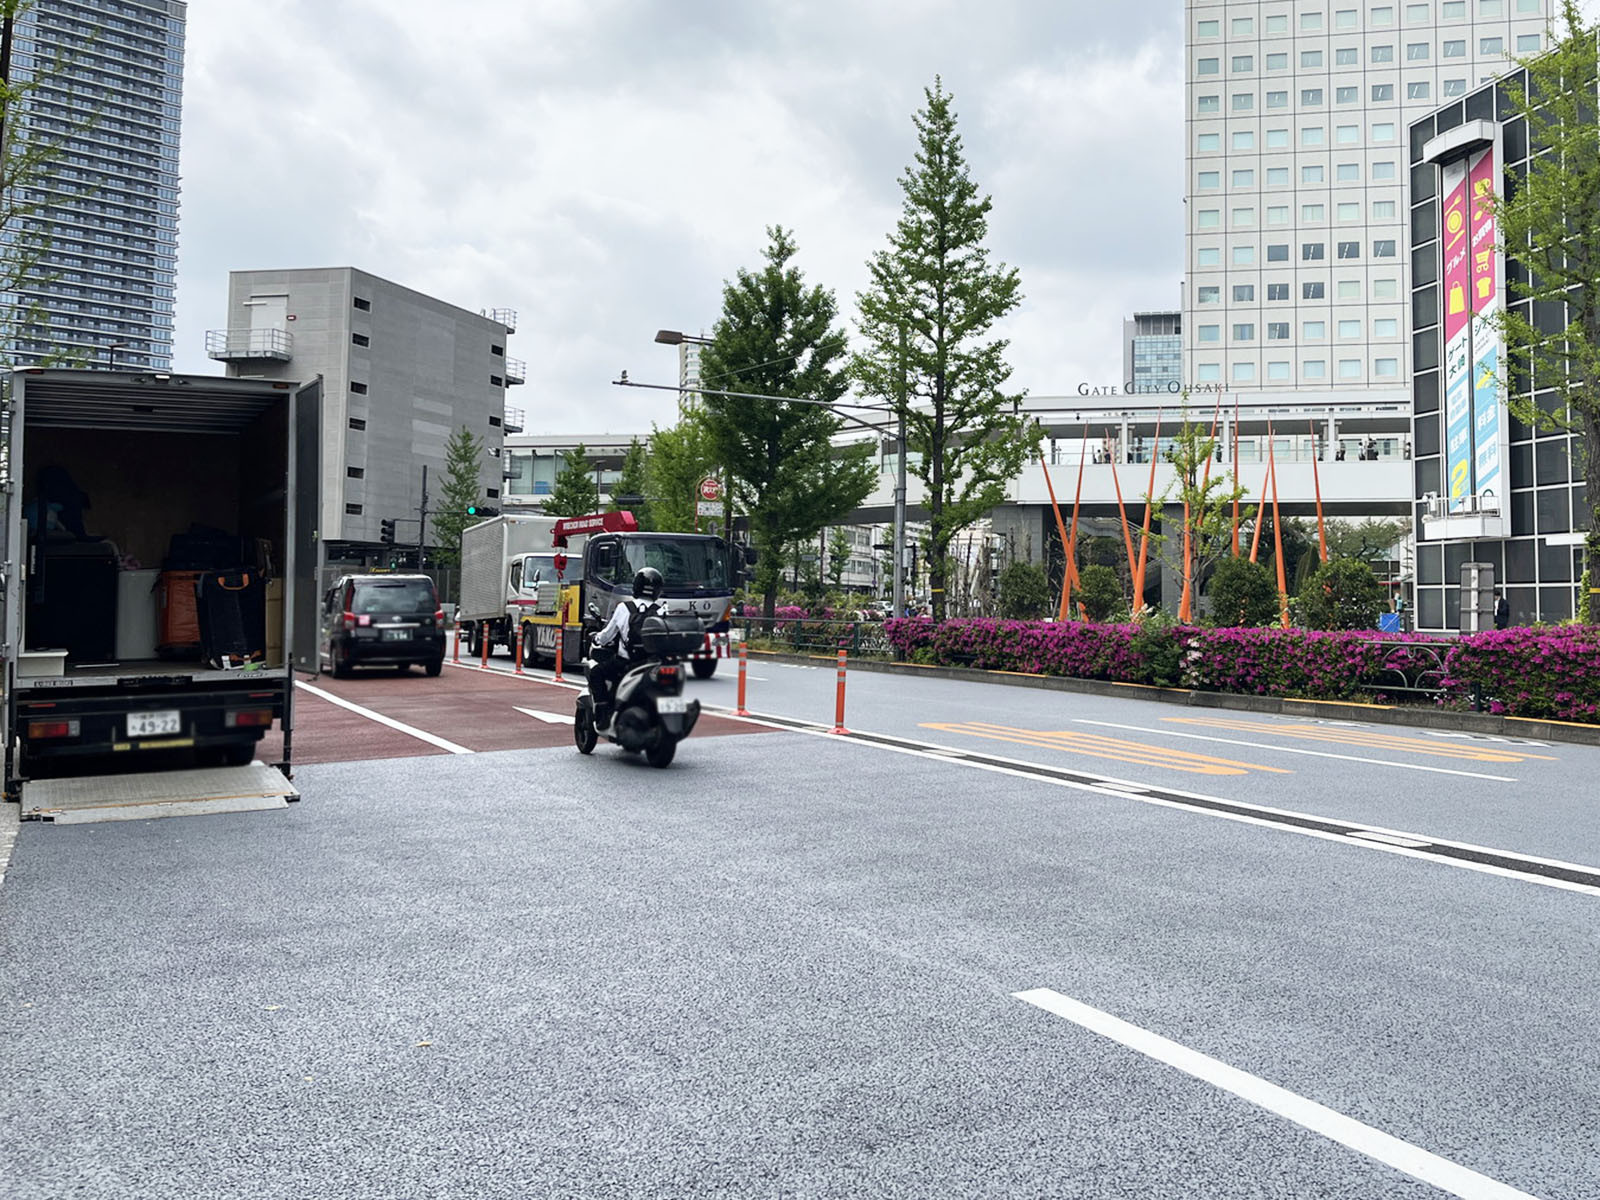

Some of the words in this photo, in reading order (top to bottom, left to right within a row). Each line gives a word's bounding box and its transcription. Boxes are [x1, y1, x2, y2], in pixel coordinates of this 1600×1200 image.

[1446, 247, 1466, 276] グルメ
[1077, 382, 1117, 396] GATE
[1124, 381, 1161, 395] CITY
[1167, 380, 1229, 394] OHSAKI
